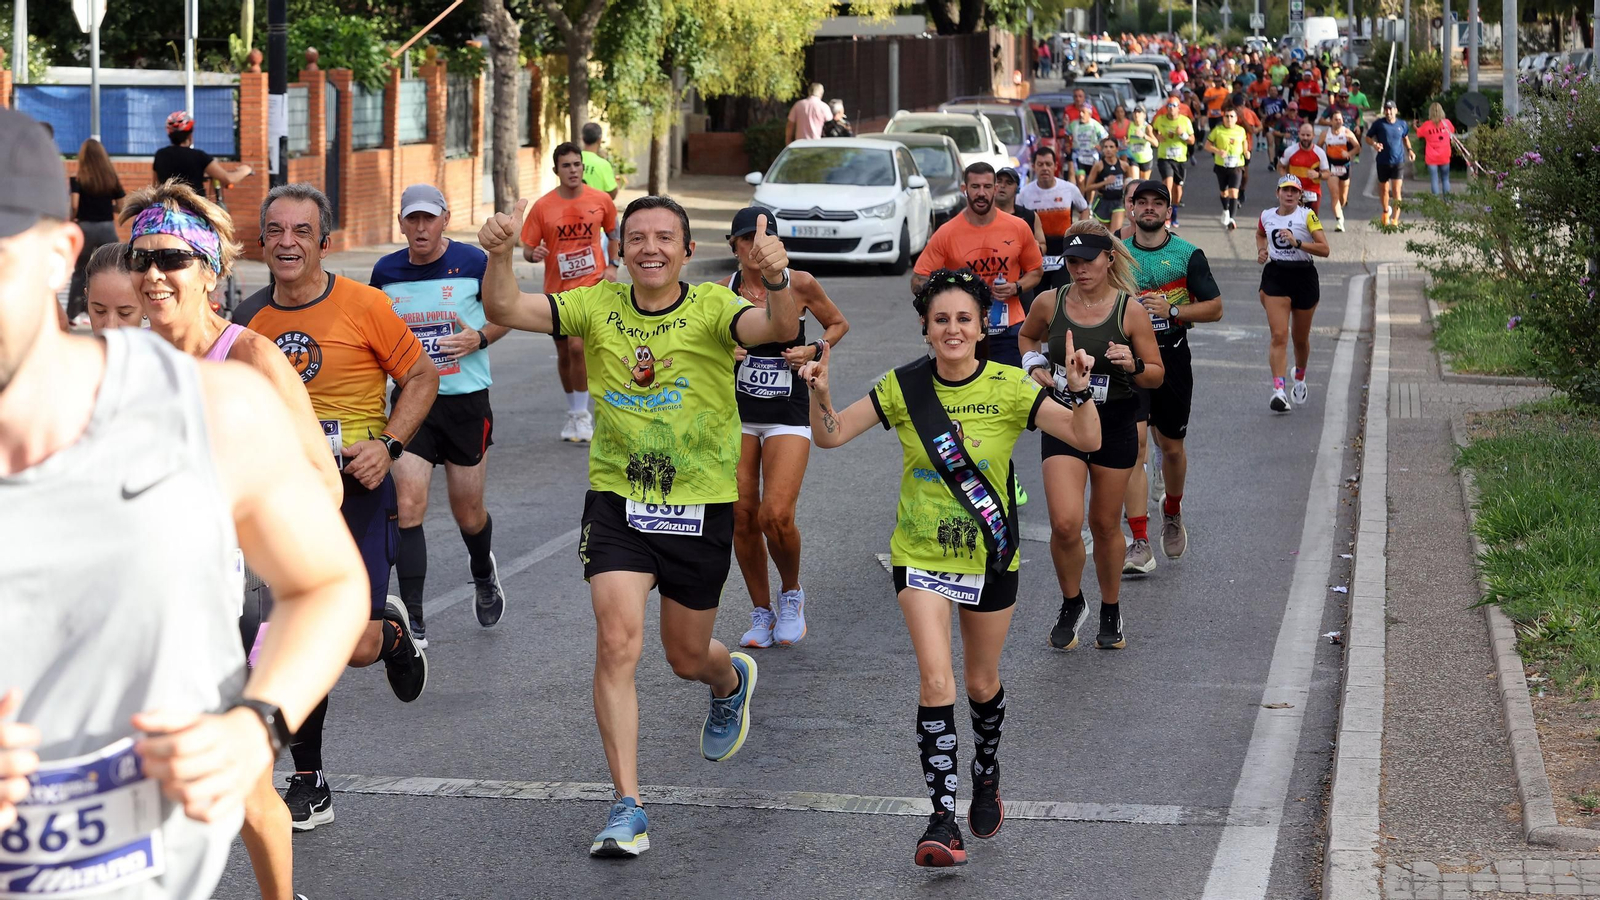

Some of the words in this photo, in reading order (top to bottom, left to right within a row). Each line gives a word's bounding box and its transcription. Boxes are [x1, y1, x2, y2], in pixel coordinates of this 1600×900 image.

[568, 258, 587, 270] 320
[402, 312, 425, 323] RRERA
[276, 333, 309, 346] BEER
[750, 370, 779, 385] 607
[603, 387, 682, 409] agarrado
[933, 431, 967, 473] FELIZ
[653, 521, 697, 532] MIZUNO
[934, 584, 976, 601] MIZUNO
[1, 803, 106, 853] 865
